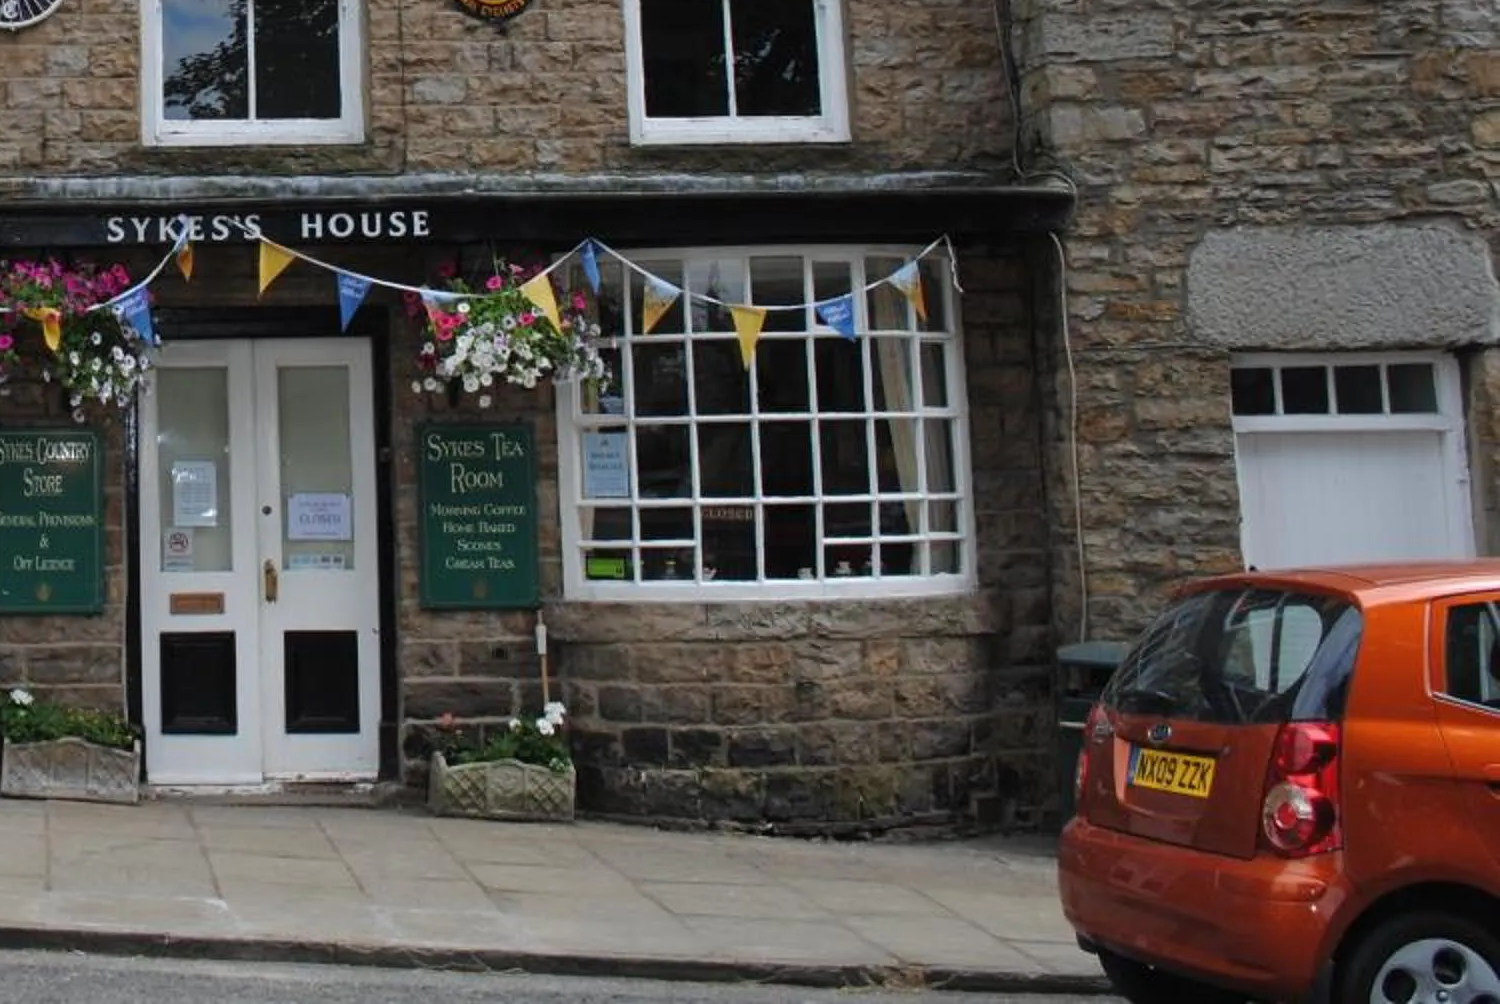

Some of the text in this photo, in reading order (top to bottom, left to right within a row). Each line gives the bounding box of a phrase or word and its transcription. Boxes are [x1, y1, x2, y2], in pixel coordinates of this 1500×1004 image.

[106, 211, 430, 243] SYKES'S HOUSE
[37, 437, 92, 466] COUNTRY
[426, 432, 524, 461] SYKES TEA
[23, 467, 63, 497] STORE
[450, 463, 504, 494] ROOM
[39, 534, 50, 548] &
[1136, 754, 1211, 792] NX09 ZZK
